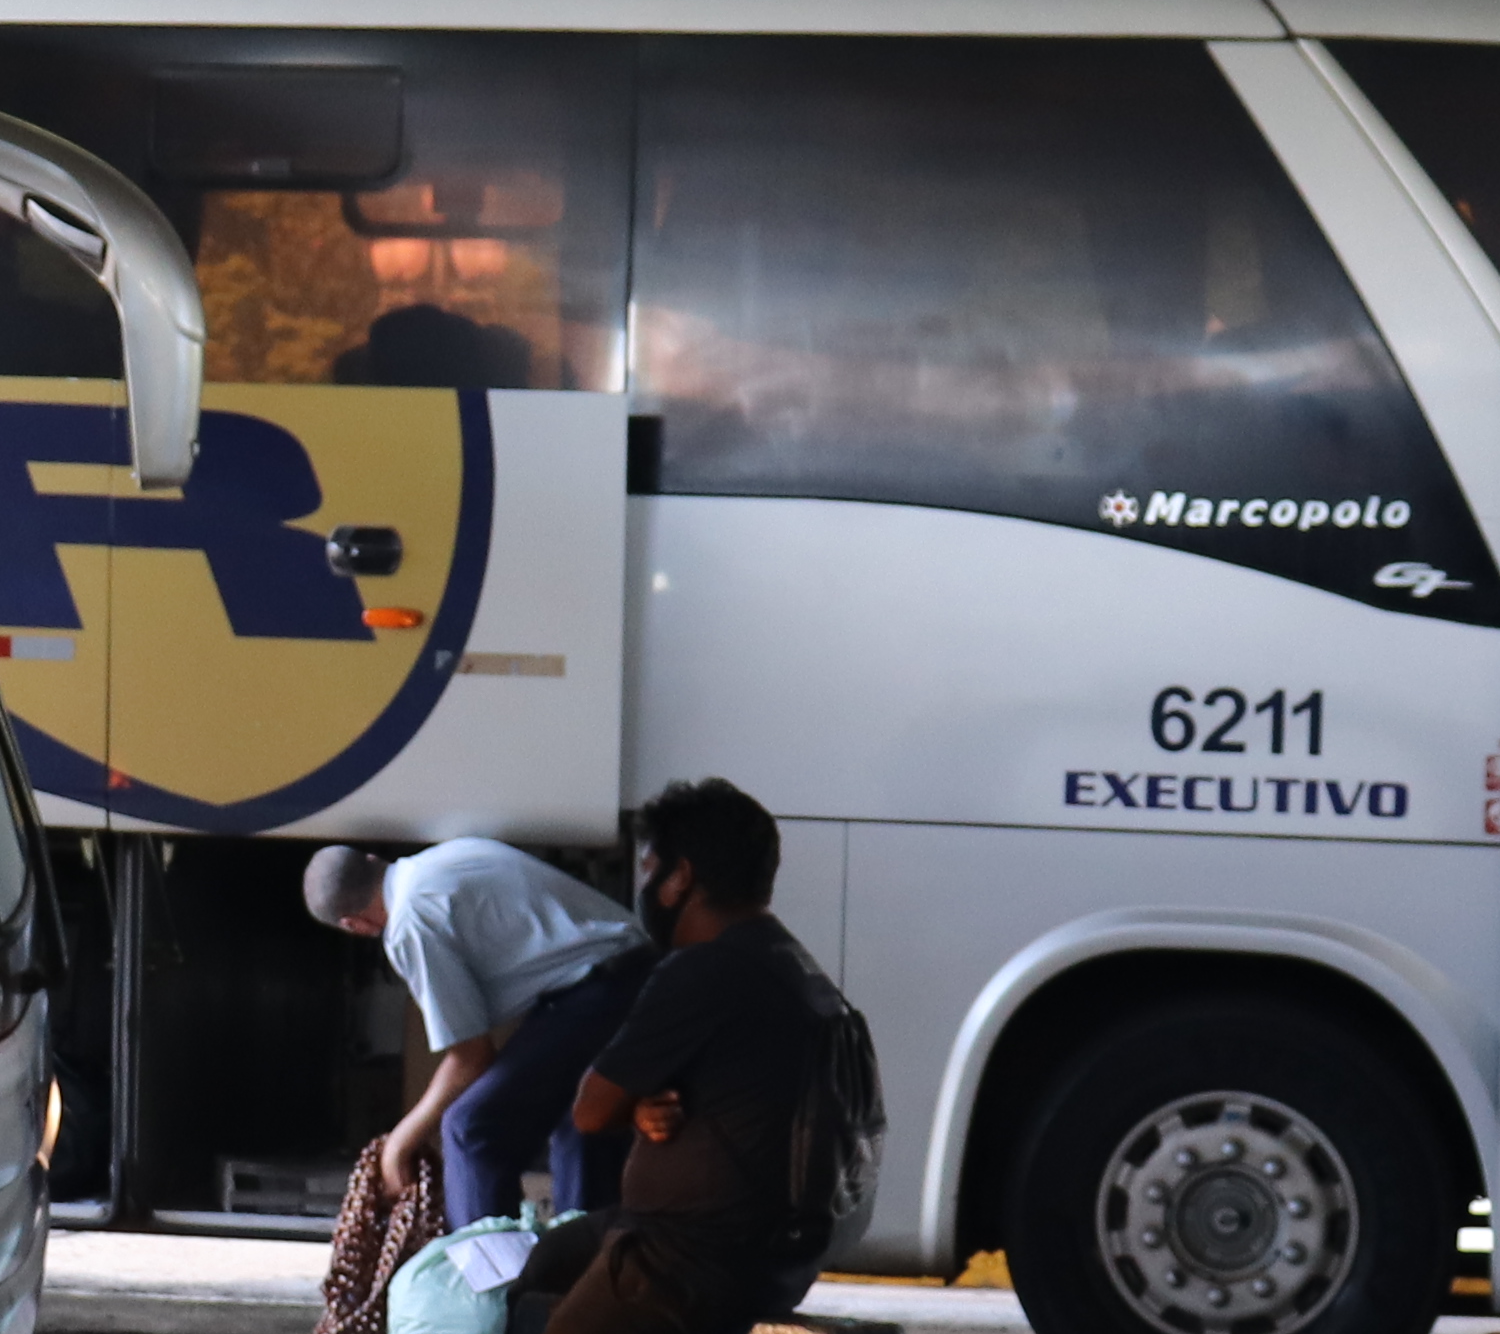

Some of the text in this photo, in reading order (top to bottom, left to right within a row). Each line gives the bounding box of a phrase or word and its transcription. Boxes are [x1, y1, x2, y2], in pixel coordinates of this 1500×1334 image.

[1145, 491, 1411, 532] Marcopolo
[1151, 687, 1323, 755] 6211
[1064, 770, 1409, 818] EXECUTIVO
